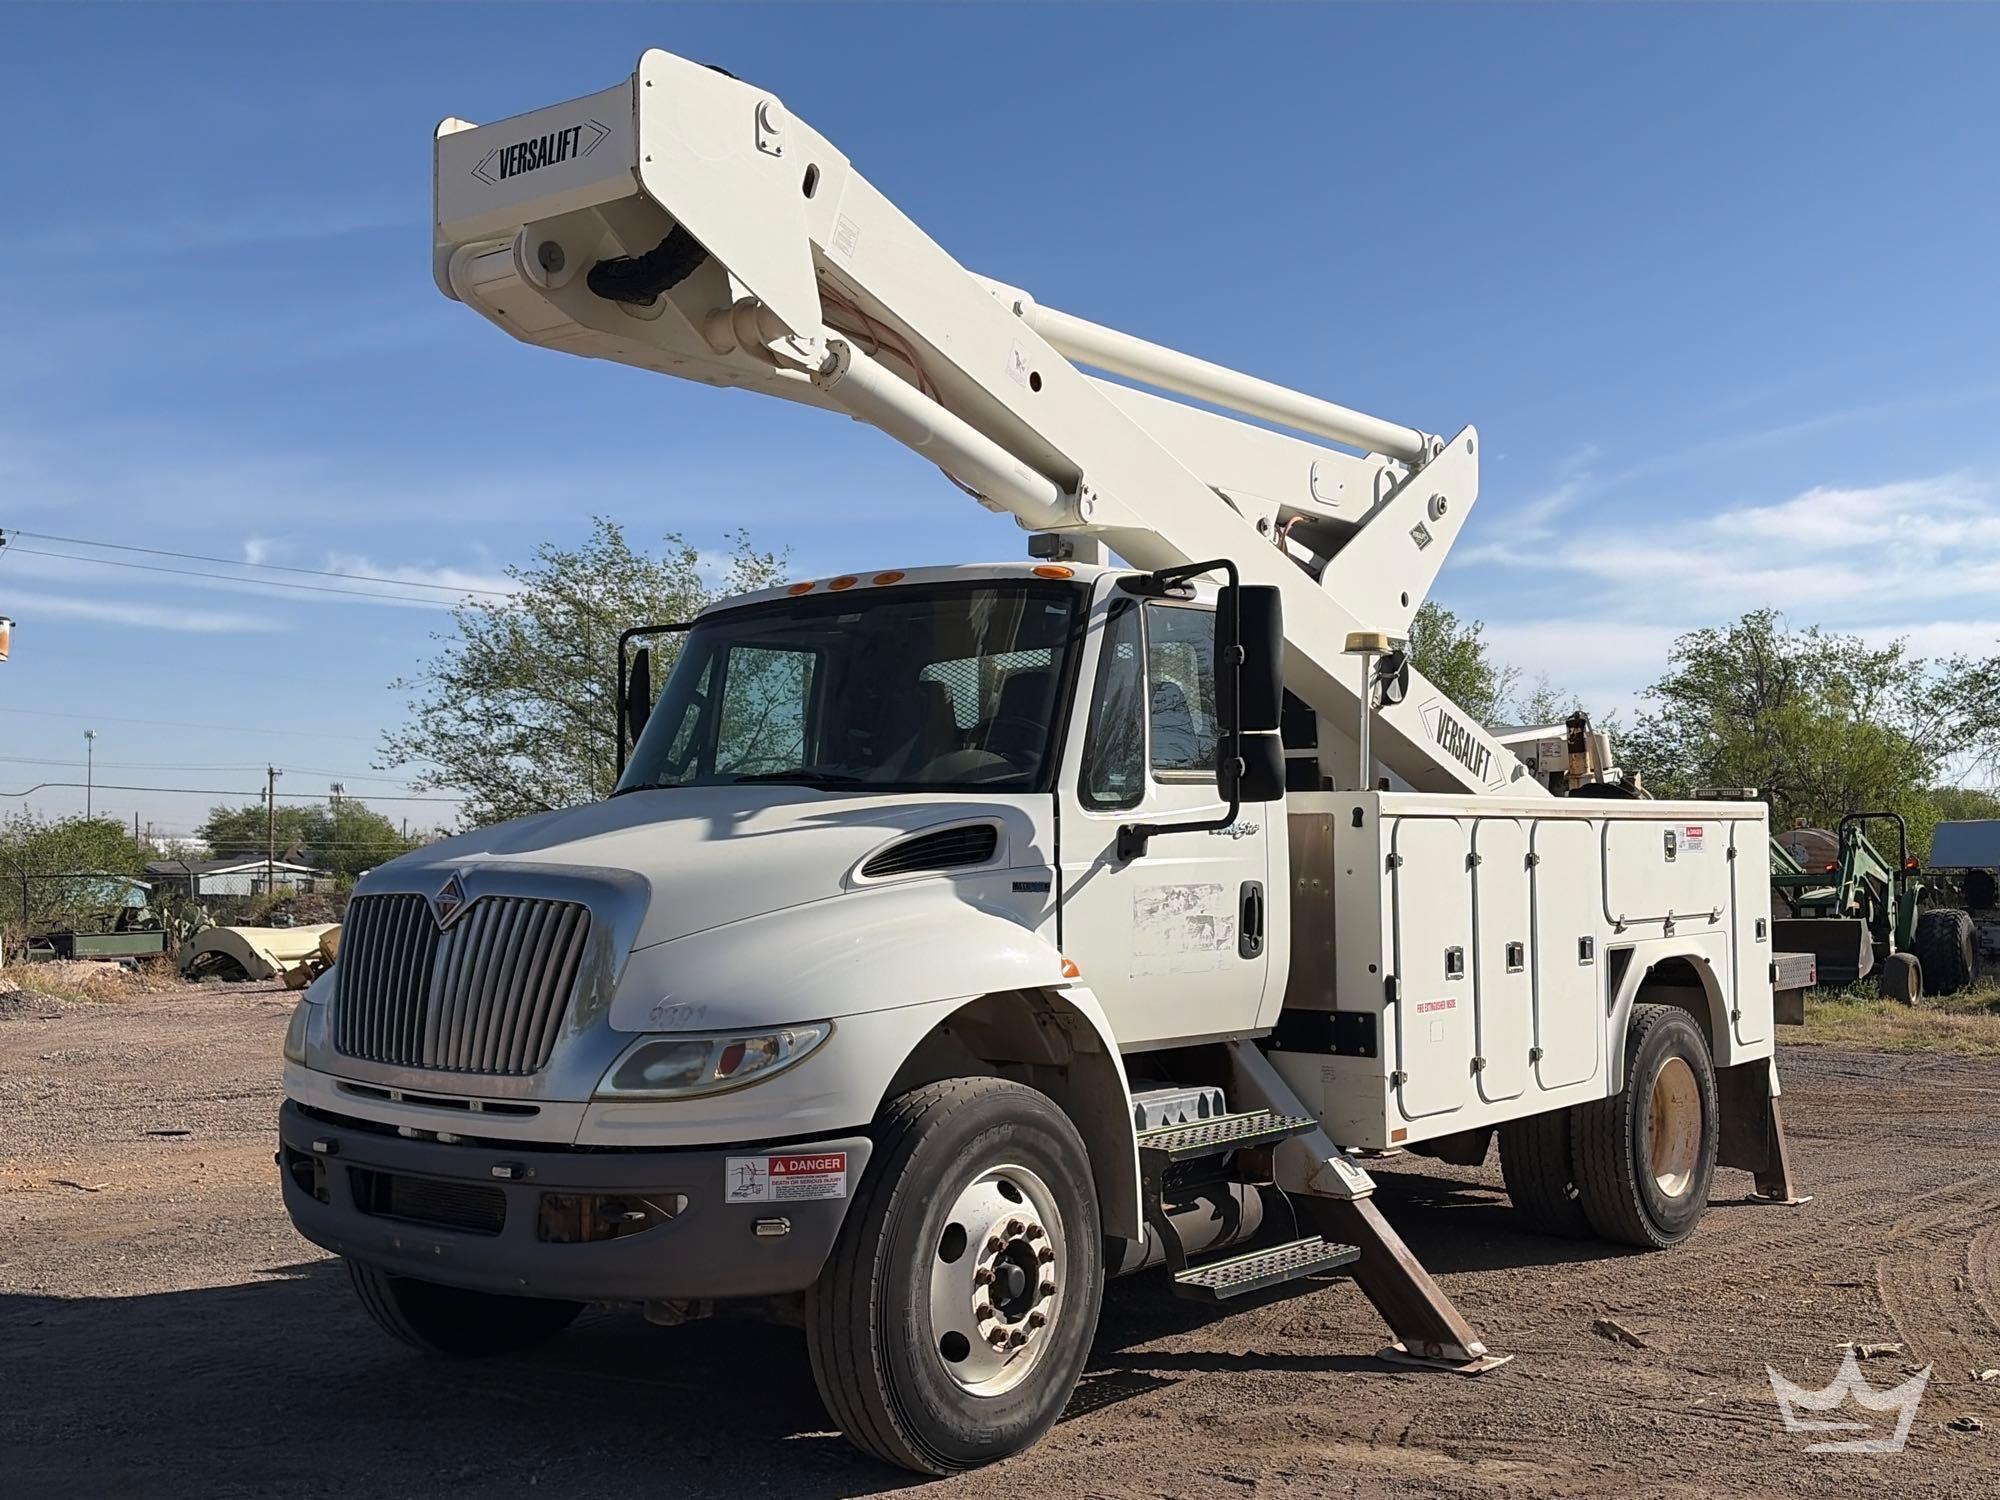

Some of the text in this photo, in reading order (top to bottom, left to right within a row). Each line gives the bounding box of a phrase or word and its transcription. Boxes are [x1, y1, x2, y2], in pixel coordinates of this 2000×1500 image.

[500, 125, 582, 180] VERSALIFT
[1437, 708, 1491, 783] VERSALIFT
[790, 1159, 840, 1170] DANGER
